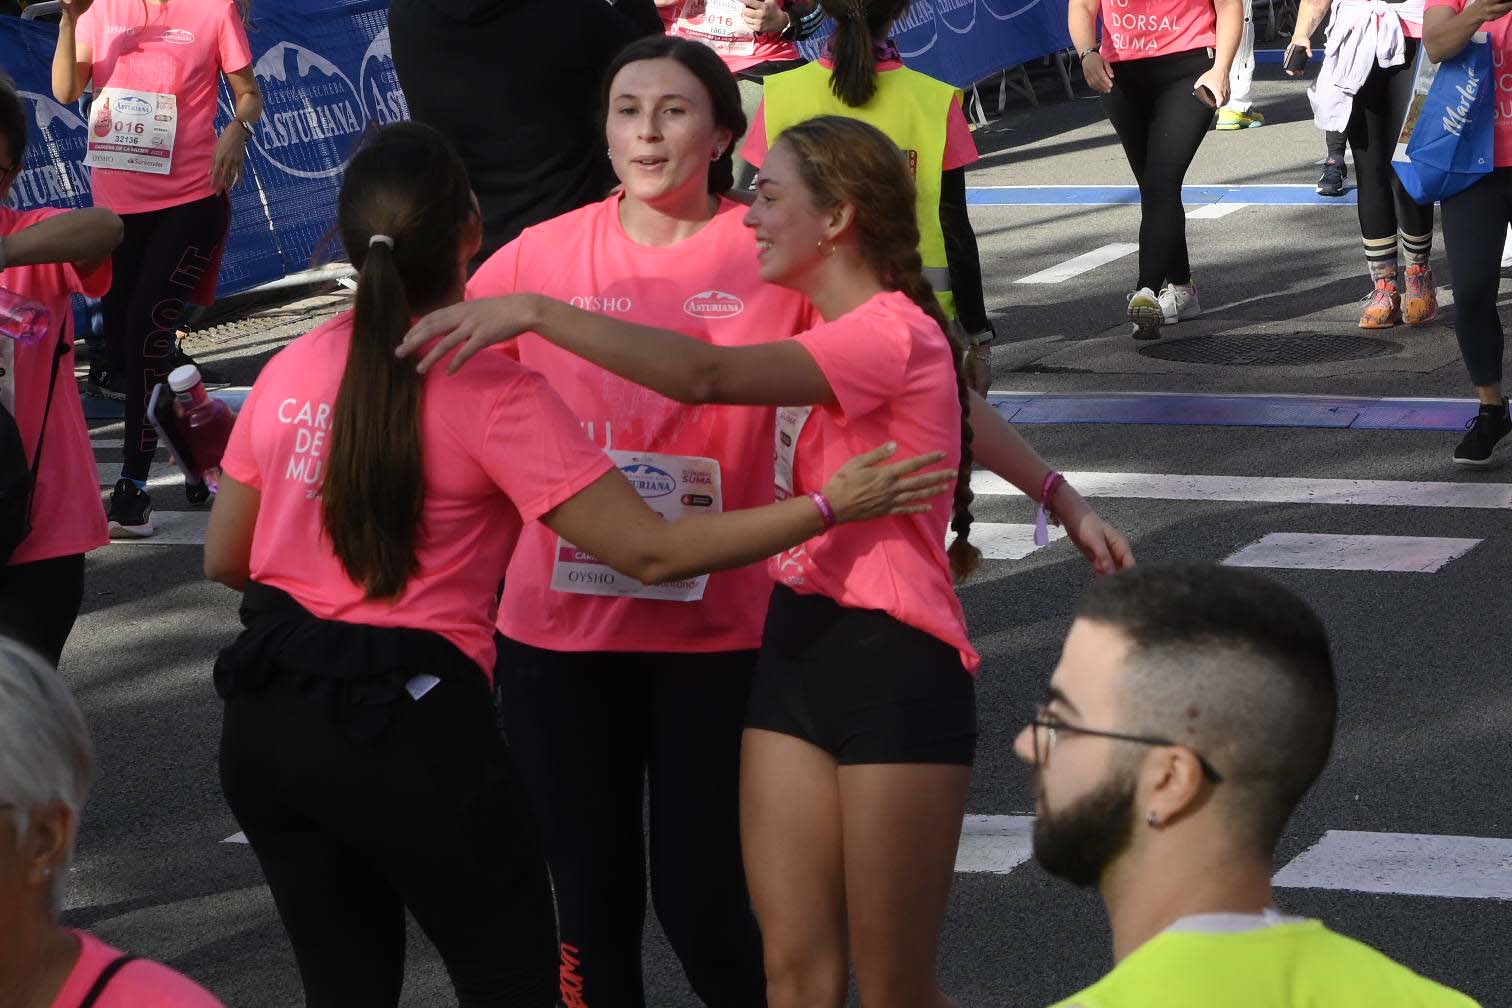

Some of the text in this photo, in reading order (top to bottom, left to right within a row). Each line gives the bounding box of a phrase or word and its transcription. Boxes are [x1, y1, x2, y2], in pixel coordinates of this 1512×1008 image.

[1112, 13, 1181, 32] DORSAL
[1112, 34, 1158, 51] SUMA
[1493, 50, 1505, 67] U
[114, 122, 145, 134] 016
[261, 98, 363, 150] ASTURIANA
[115, 135, 139, 144] 32136
[570, 296, 632, 312] OYSHO
[278, 397, 335, 431] CAR
[296, 429, 326, 456] DE
[285, 456, 325, 486] MU
[682, 475, 712, 485] SUMA
[568, 570, 615, 585] OYSHO
